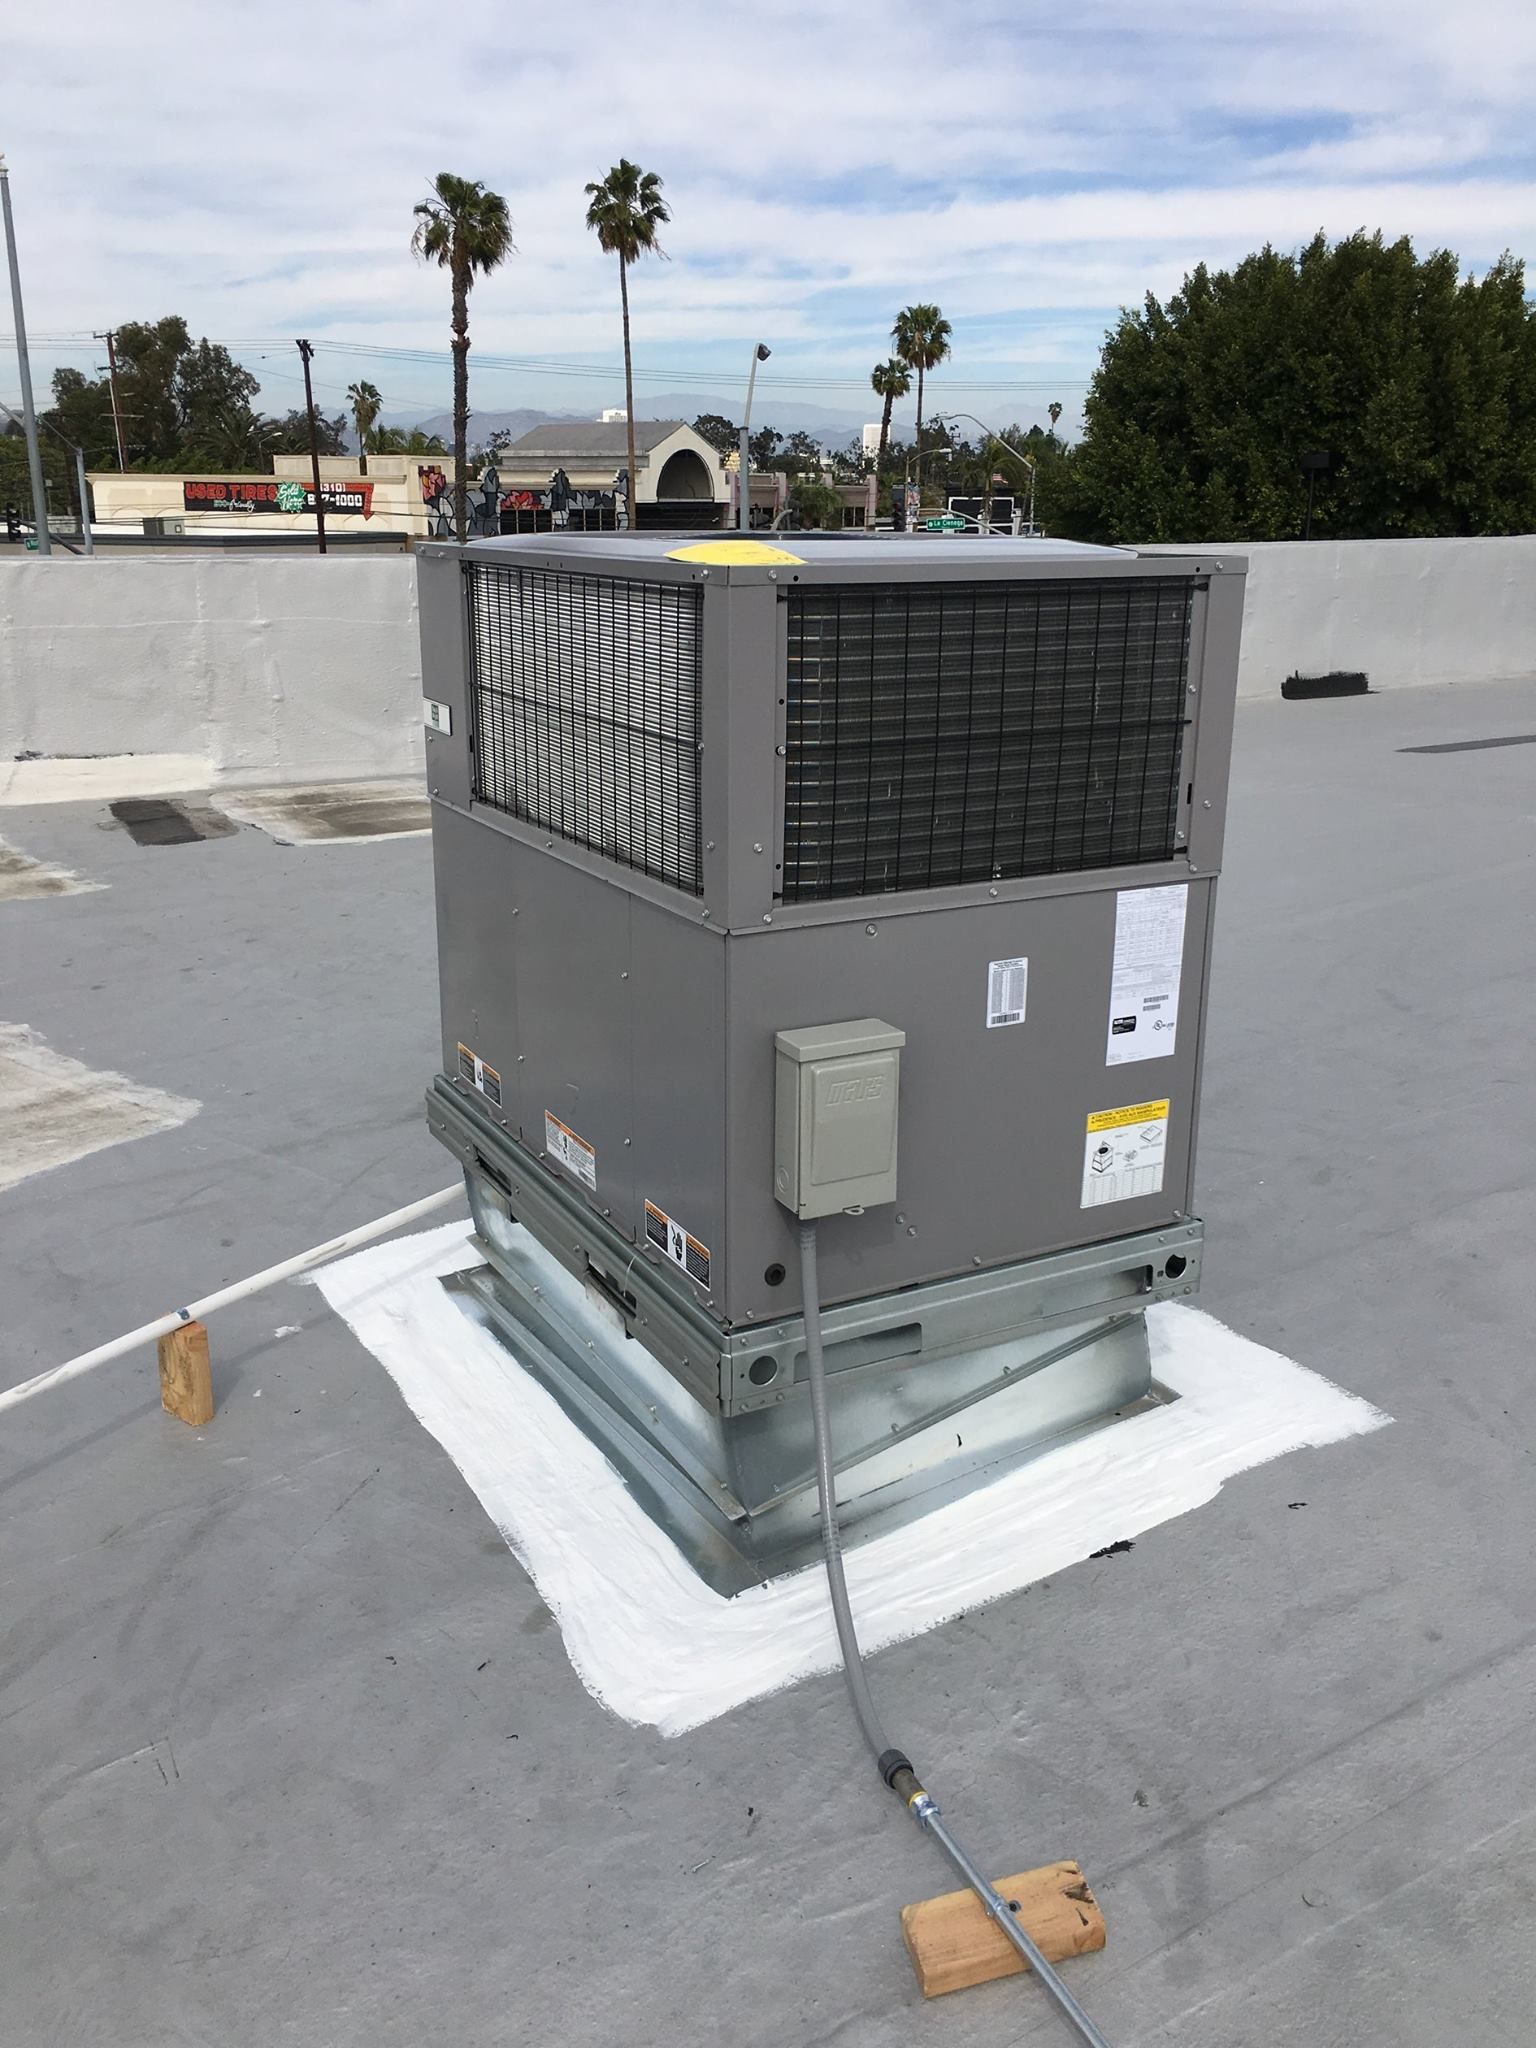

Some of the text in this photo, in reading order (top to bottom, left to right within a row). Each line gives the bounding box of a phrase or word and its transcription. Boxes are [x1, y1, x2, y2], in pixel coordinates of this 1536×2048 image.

[185, 483, 277, 501] USED TIRES
[320, 483, 346, 492] (310)
[307, 494, 363, 506] 87-1000
[942, 520, 963, 528] Cienega
